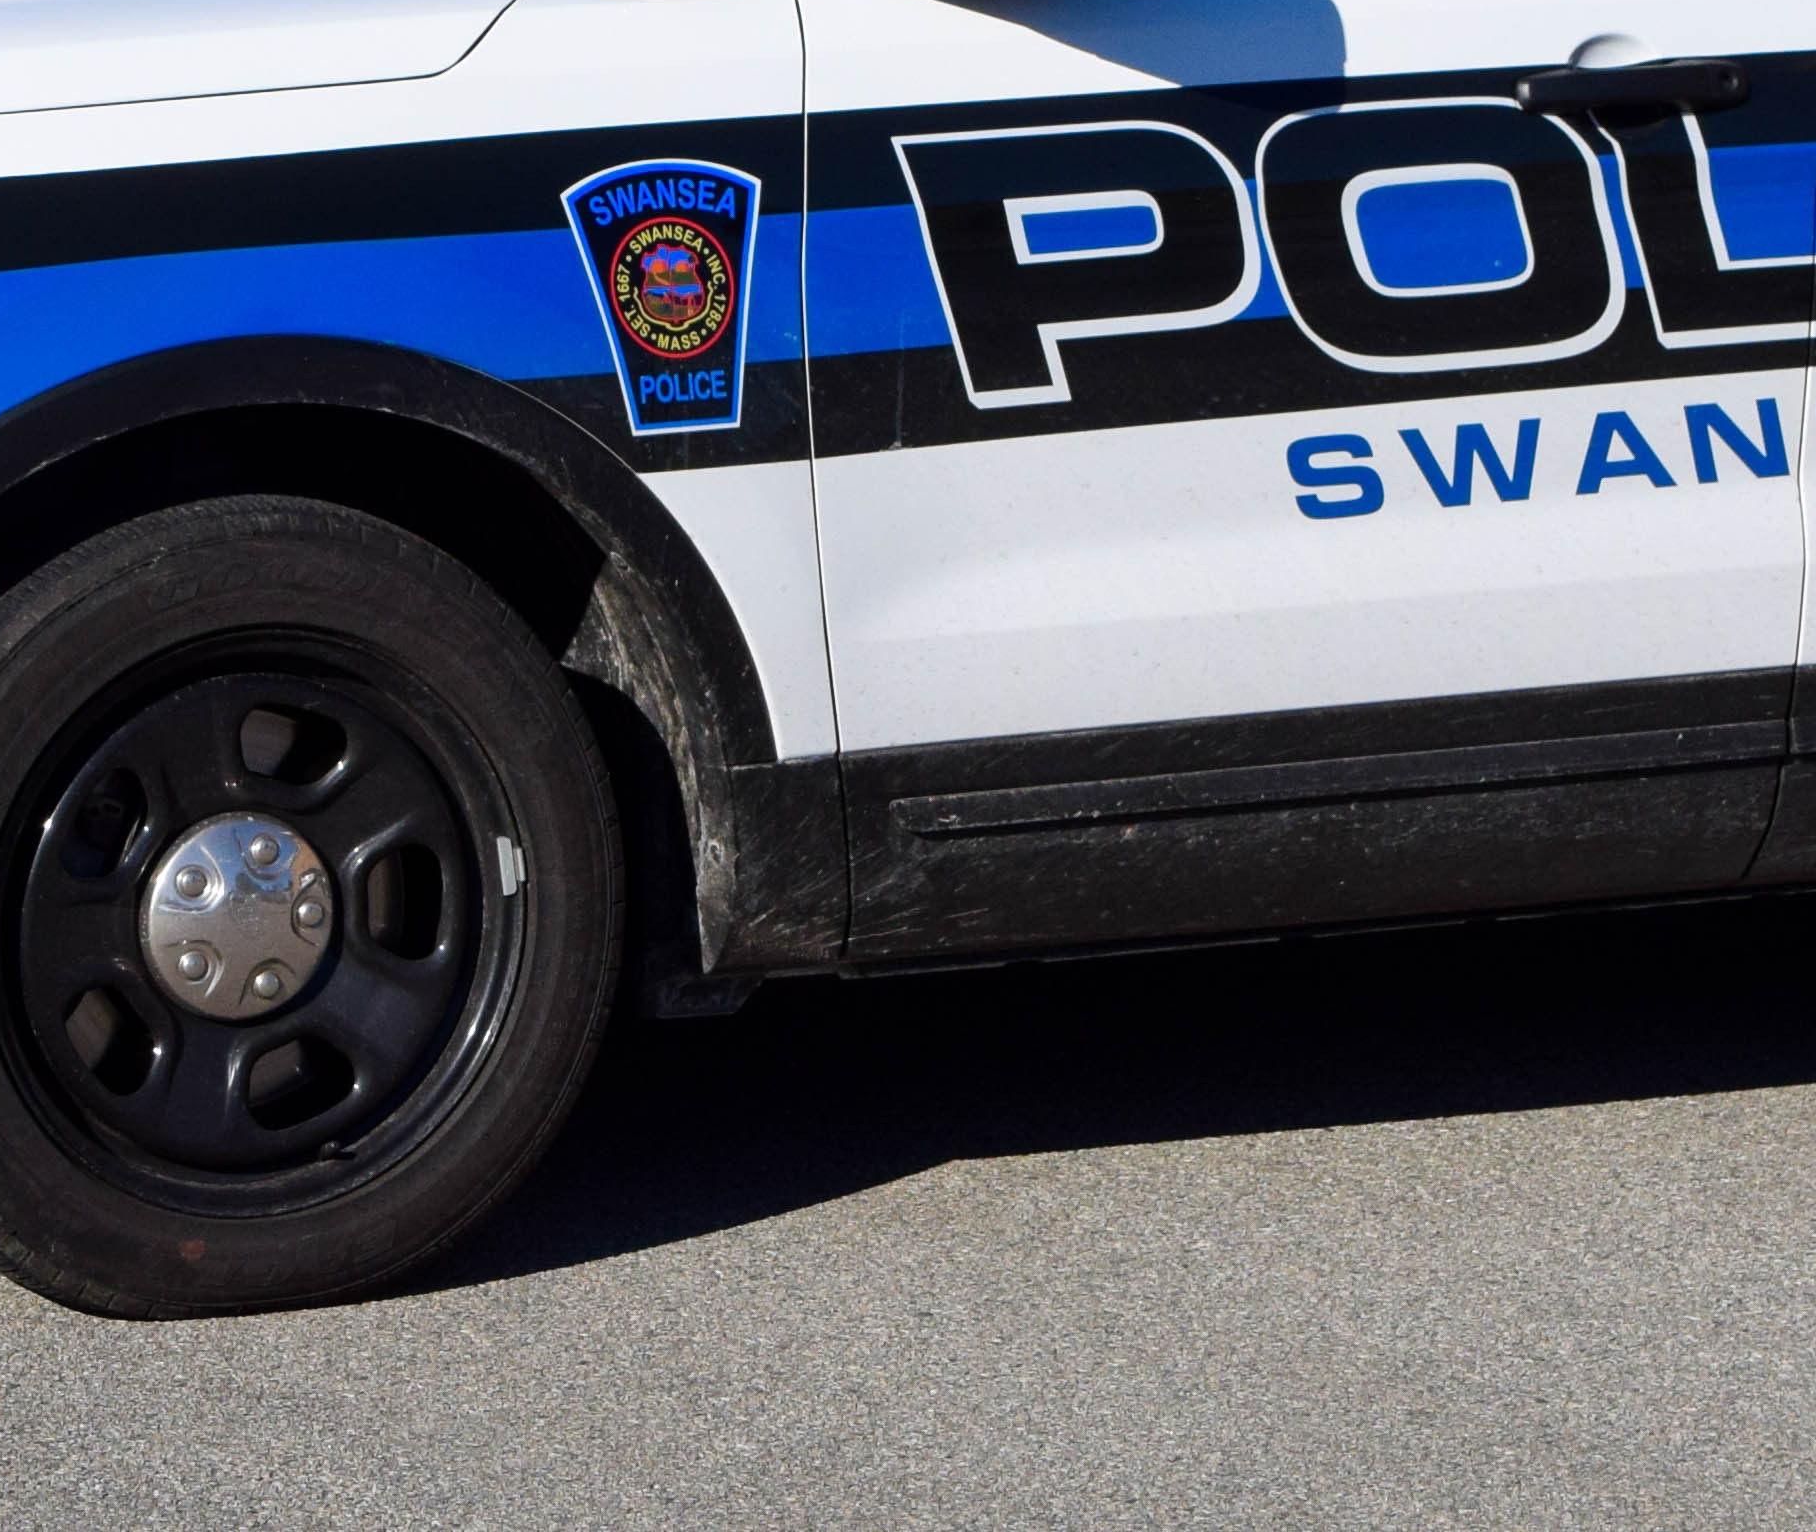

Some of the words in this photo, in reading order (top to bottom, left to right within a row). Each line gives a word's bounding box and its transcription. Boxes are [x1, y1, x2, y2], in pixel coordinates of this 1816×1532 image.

[588, 178, 737, 226] SWANSEA
[629, 224, 704, 254] SWANSEA
[616, 264, 631, 302] 1667
[705, 292, 727, 330] 1785
[657, 331, 701, 350] MASS
[639, 370, 728, 405] POLICE
